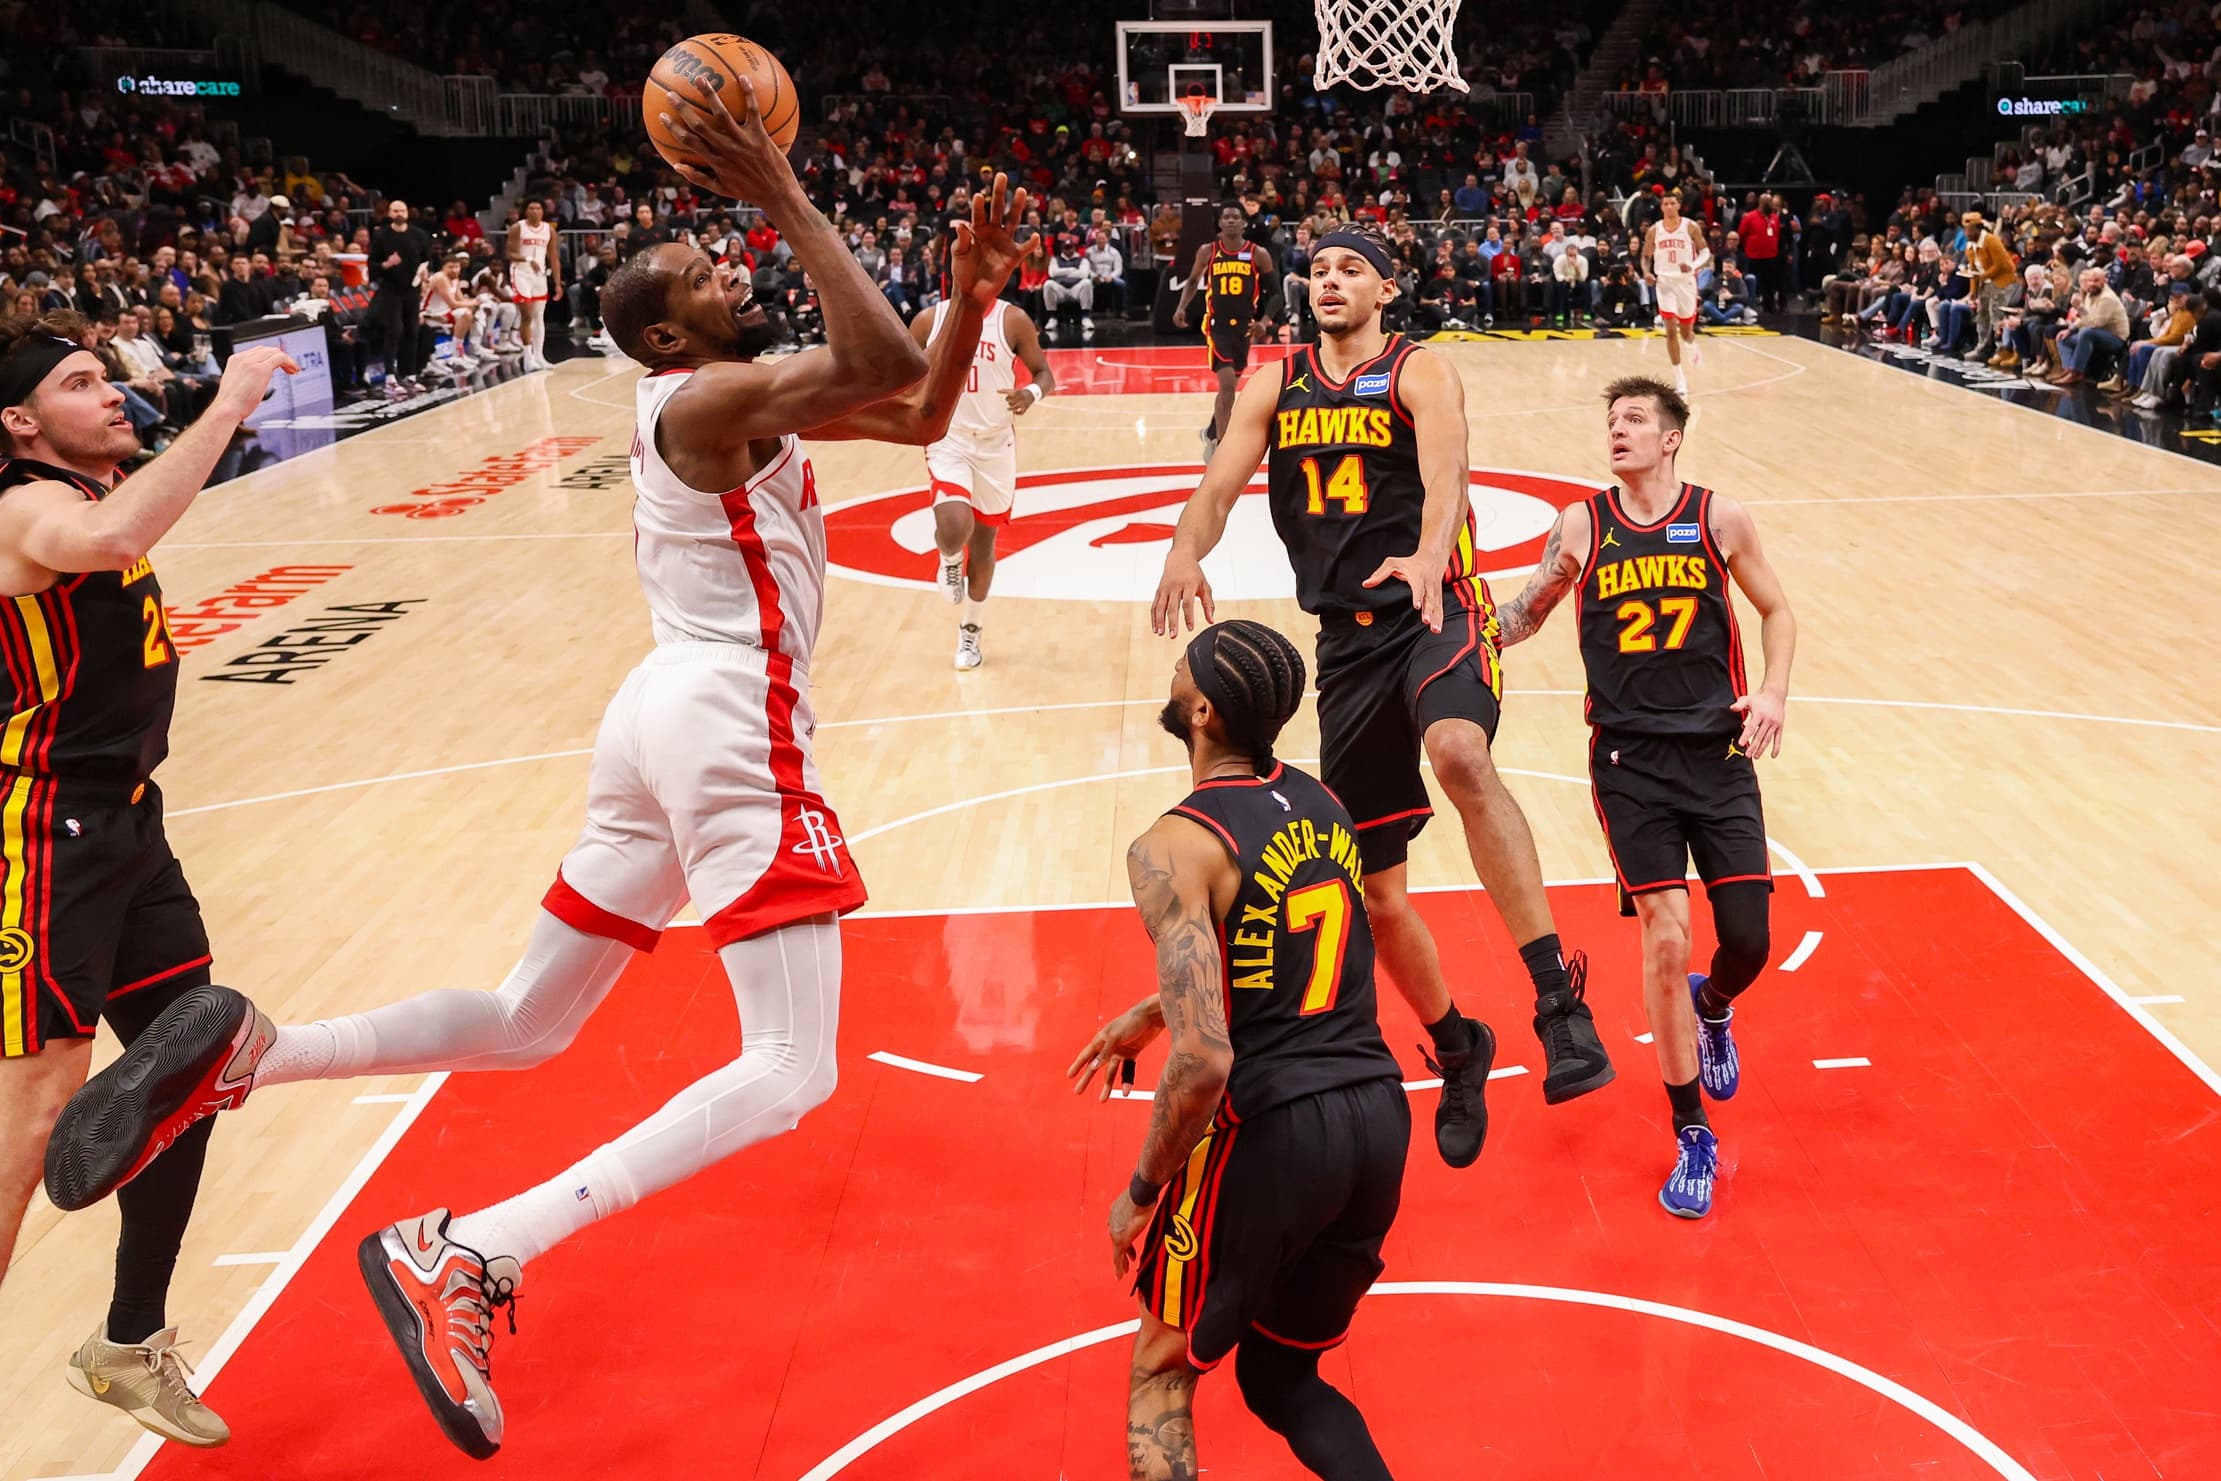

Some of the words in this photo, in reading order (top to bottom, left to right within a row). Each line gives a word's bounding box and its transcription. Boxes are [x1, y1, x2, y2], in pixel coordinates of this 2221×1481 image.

[1212, 261, 1252, 276] HAWKS
[1219, 276, 1243, 295] 18
[1358, 378, 1387, 390] paze
[1277, 406, 1393, 450] HAWKS
[1298, 453, 1369, 515] 14
[1596, 554, 1708, 600] HAWKS
[142, 594, 173, 669] 2
[197, 598, 429, 684] ARENA
[1616, 596, 1699, 654] 27
[1232, 818, 1366, 990] ALEXANDER-WAL
[1285, 877, 1353, 1017] 7
